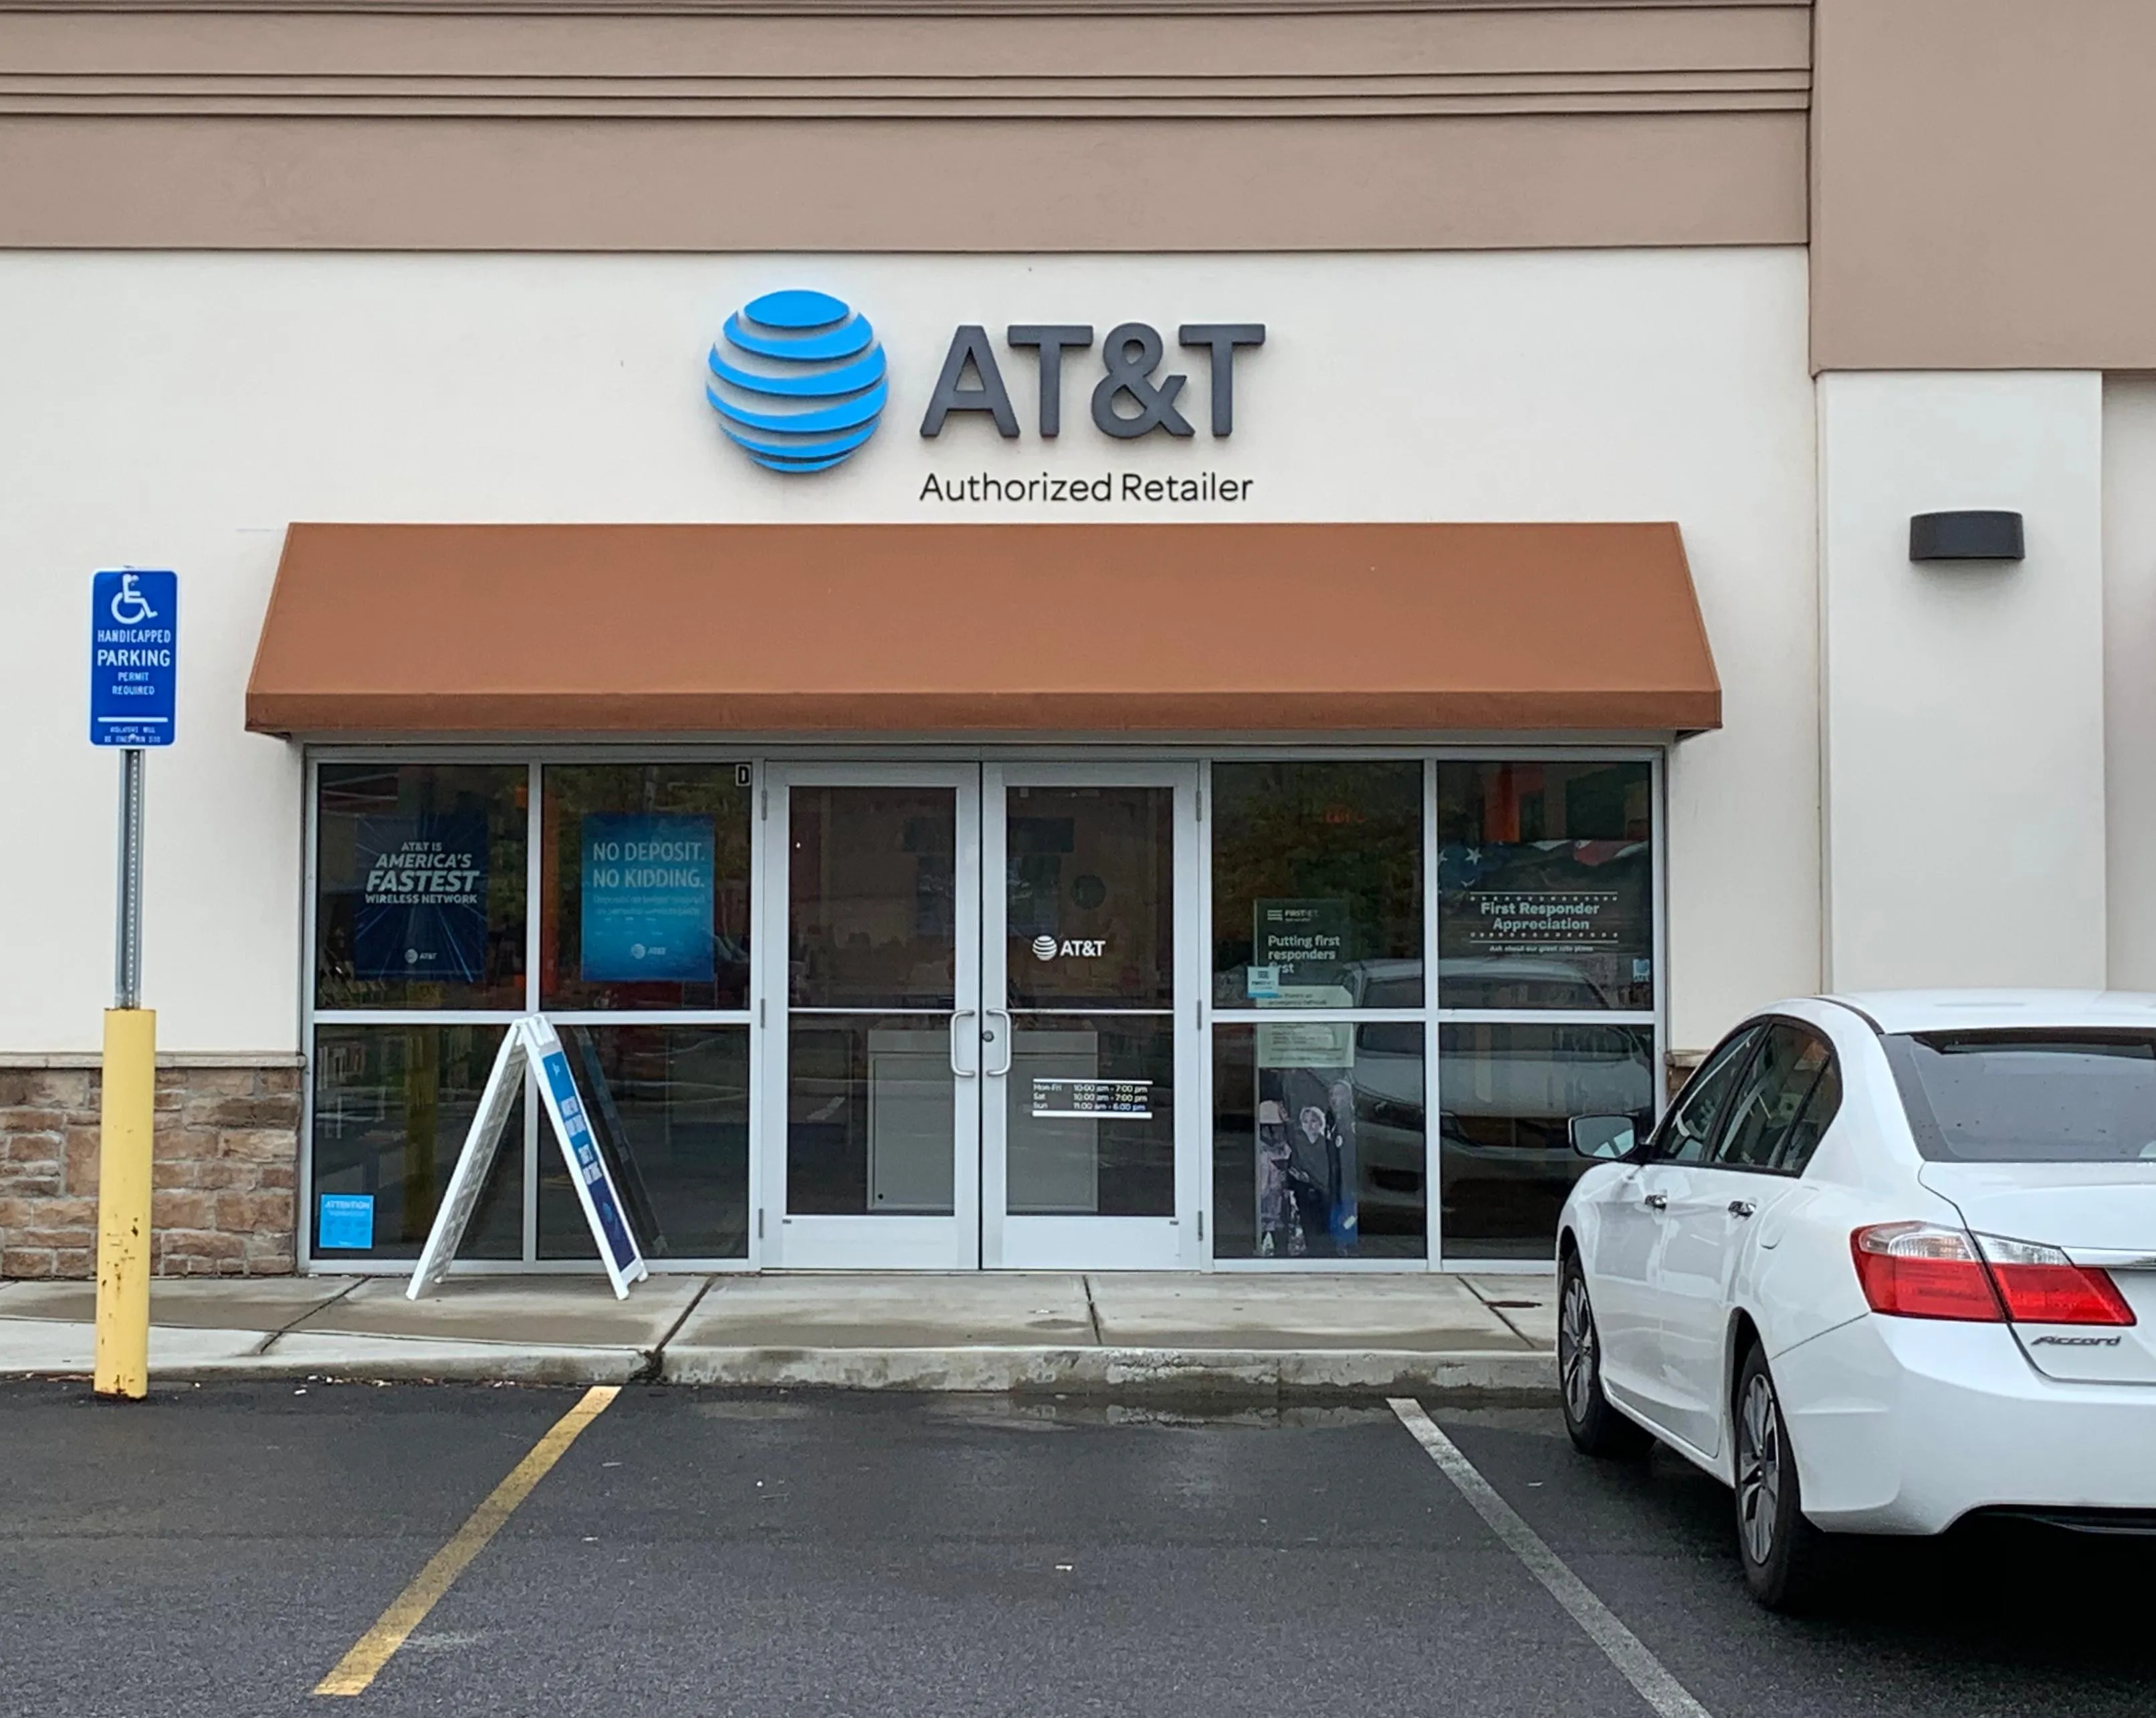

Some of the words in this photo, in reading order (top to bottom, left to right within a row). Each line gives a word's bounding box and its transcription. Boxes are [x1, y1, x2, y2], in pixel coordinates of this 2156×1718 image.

[920, 322, 1266, 440] AT&T
[920, 471, 1112, 503] Authorized
[1122, 471, 1253, 503] Retailer
[97, 629, 171, 643] HANDICAPPED
[97, 649, 171, 667] PARKING
[118, 671, 149, 681] PERMIT
[112, 685, 155, 695] REQUIRED
[738, 766, 749, 784] D
[401, 841, 429, 852] AT&T
[432, 841, 442, 852] IS
[593, 842, 619, 861] NO
[625, 841, 705, 861] DEPOSIT.
[375, 853, 472, 869] AMERICA'S
[366, 870, 480, 892] FASTEST
[593, 869, 619, 888] NO
[625, 869, 705, 888] KIDDING.
[365, 893, 419, 904] WIRELESS
[421, 893, 477, 904] NETWORK
[1481, 903, 1515, 914] First
[1519, 902, 1599, 917] Responder
[1493, 918, 1590, 932] Appreciation
[1060, 940, 1105, 956] AT&T
[1268, 935, 1312, 948] Putting
[1315, 935, 1340, 946] first
[419, 952, 437, 960] AT&T
[1268, 949, 1335, 962] responders
[325, 1200, 370, 1209] ATTENTION
[2030, 1335, 2122, 1346] Accord
